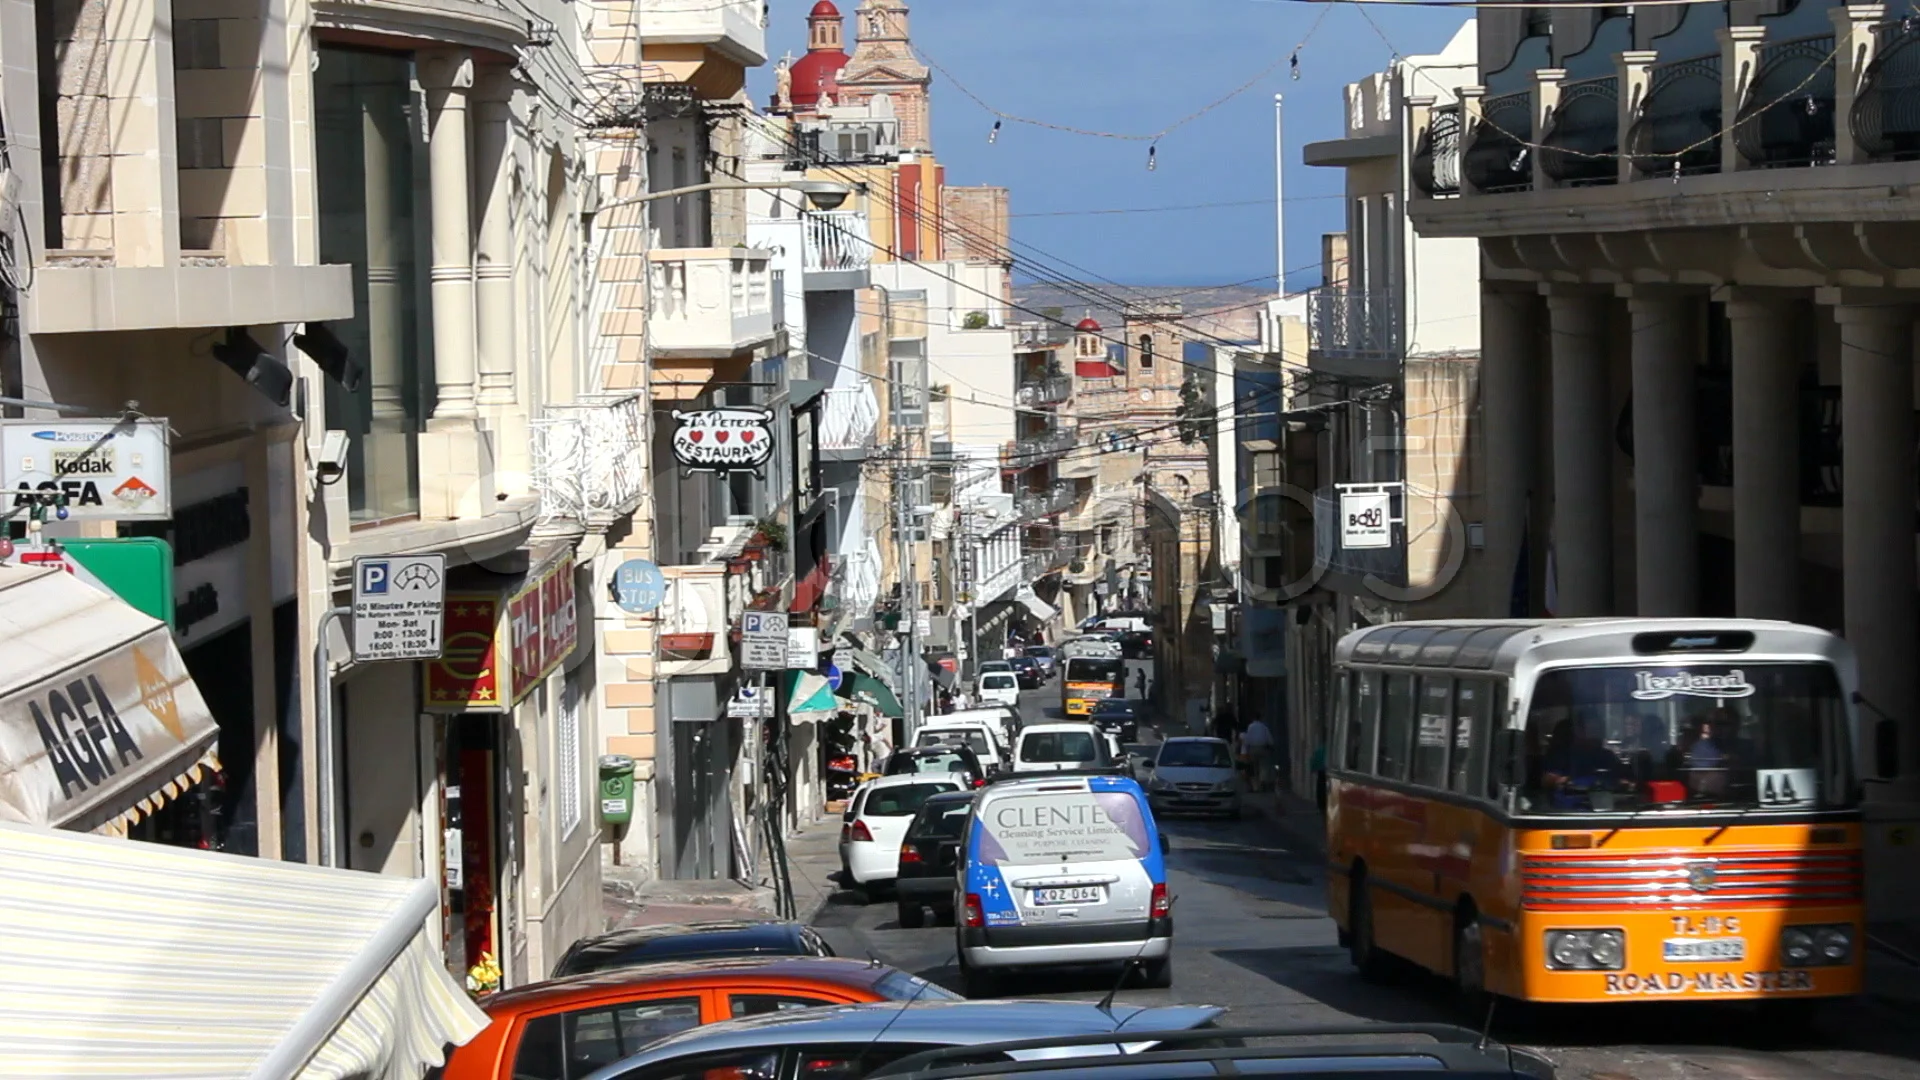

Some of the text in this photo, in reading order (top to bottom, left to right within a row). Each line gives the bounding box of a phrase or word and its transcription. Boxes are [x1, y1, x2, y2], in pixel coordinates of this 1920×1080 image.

[676, 437, 769, 458] RESTAURANT
[55, 459, 113, 473] Kodak
[366, 567, 384, 591] P
[624, 569, 653, 584] BUS
[620, 590, 656, 604] STOP
[370, 602, 404, 610] Minutes
[407, 601, 441, 610] Parking
[747, 617, 758, 630] P
[374, 631, 393, 639] 9:00
[402, 629, 427, 638] 13:00
[402, 640, 427, 648] 18:30
[28, 674, 144, 800] AGFA
[997, 804, 1126, 828] CLENTEC
[998, 829, 1044, 839] Cleaning
[1047, 828, 1084, 837] Service
[1040, 887, 1098, 901] KQZ 064
[1604, 972, 1815, 994] ROAD-MASTER
